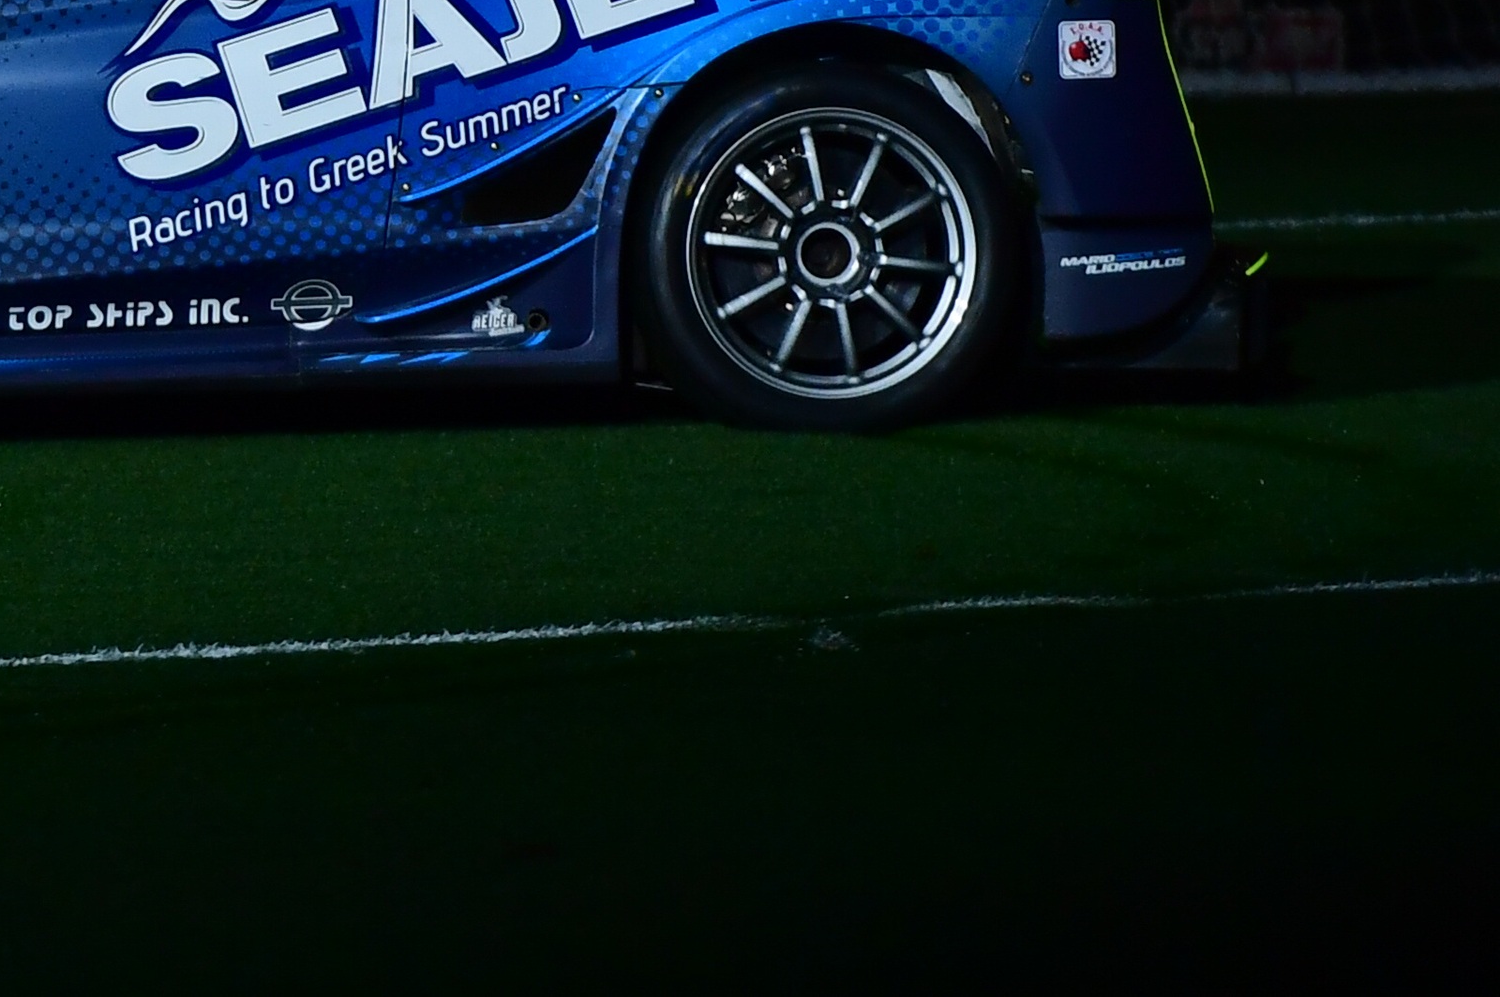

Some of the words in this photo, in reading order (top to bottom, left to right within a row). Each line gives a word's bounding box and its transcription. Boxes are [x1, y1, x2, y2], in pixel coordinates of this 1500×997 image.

[127, 191, 250, 253] Racing
[258, 174, 295, 210] to
[307, 135, 409, 194] Greek
[419, 85, 568, 157] Summer
[1060, 253, 1116, 267] MARIO
[1085, 255, 1187, 275] ILIOPOULOS
[8, 304, 73, 331] TOP
